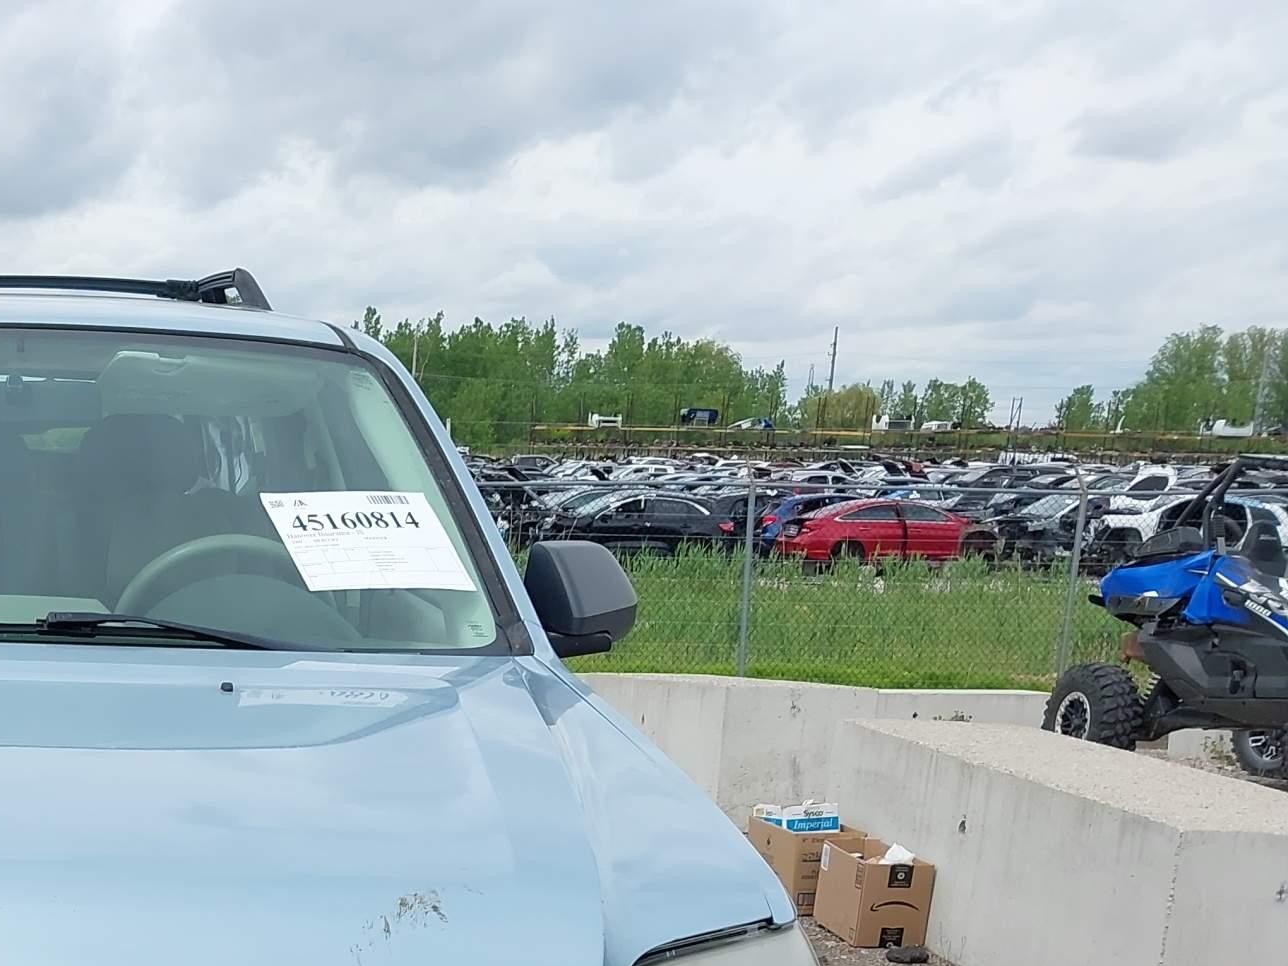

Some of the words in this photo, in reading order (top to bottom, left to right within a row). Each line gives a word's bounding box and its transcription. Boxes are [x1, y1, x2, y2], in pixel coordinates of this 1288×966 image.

[292, 511, 420, 532] 45160814
[803, 809, 824, 818] Sysco
[793, 818, 833, 831] Imperial
